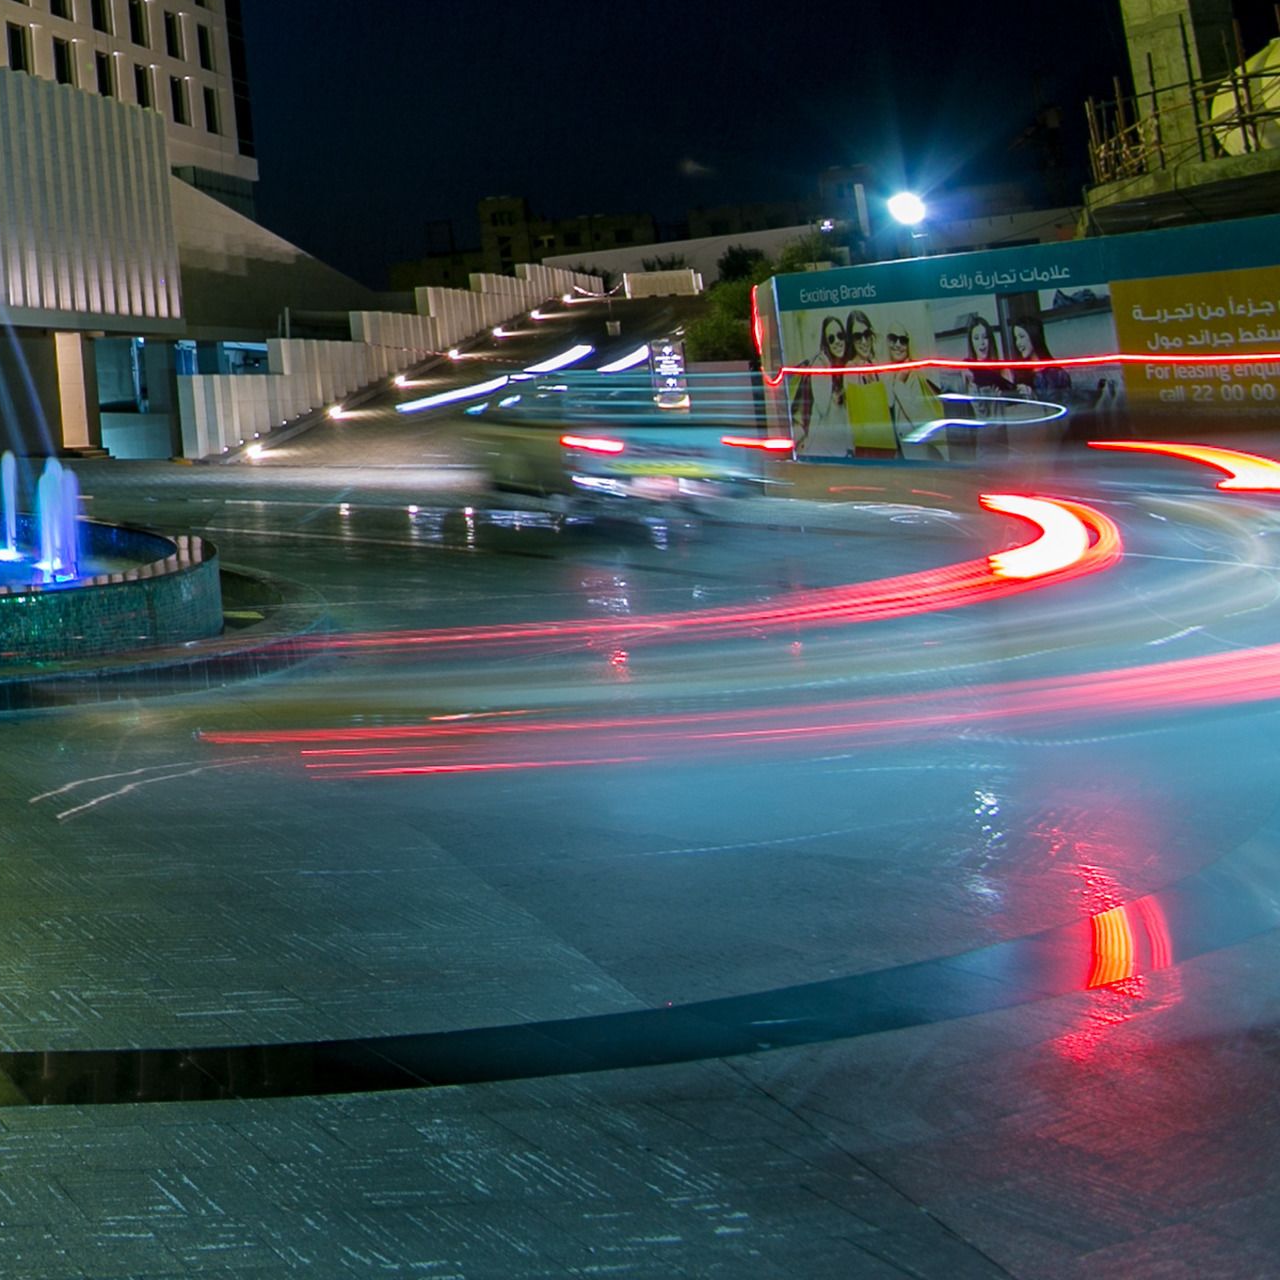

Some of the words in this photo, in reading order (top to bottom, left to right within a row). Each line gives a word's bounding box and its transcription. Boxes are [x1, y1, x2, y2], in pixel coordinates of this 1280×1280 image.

[939, 272, 973, 290] رائعة
[975, 269, 1018, 290] تجارية
[1019, 265, 1071, 282] علامات
[800, 288, 839, 304] Exciting
[840, 282, 877, 300] Brands
[1197, 302, 1226, 320] من
[1146, 332, 1183, 350] مول
[1187, 329, 1235, 347] جراند
[1238, 324, 1280, 342] سقط
[1145, 363, 1170, 379] For
[1174, 363, 1231, 382] leasing
[1159, 385, 1185, 402] call
[1192, 385, 1214, 401] 22
[1221, 384, 1244, 401] 00
[1251, 383, 1275, 400] 00
